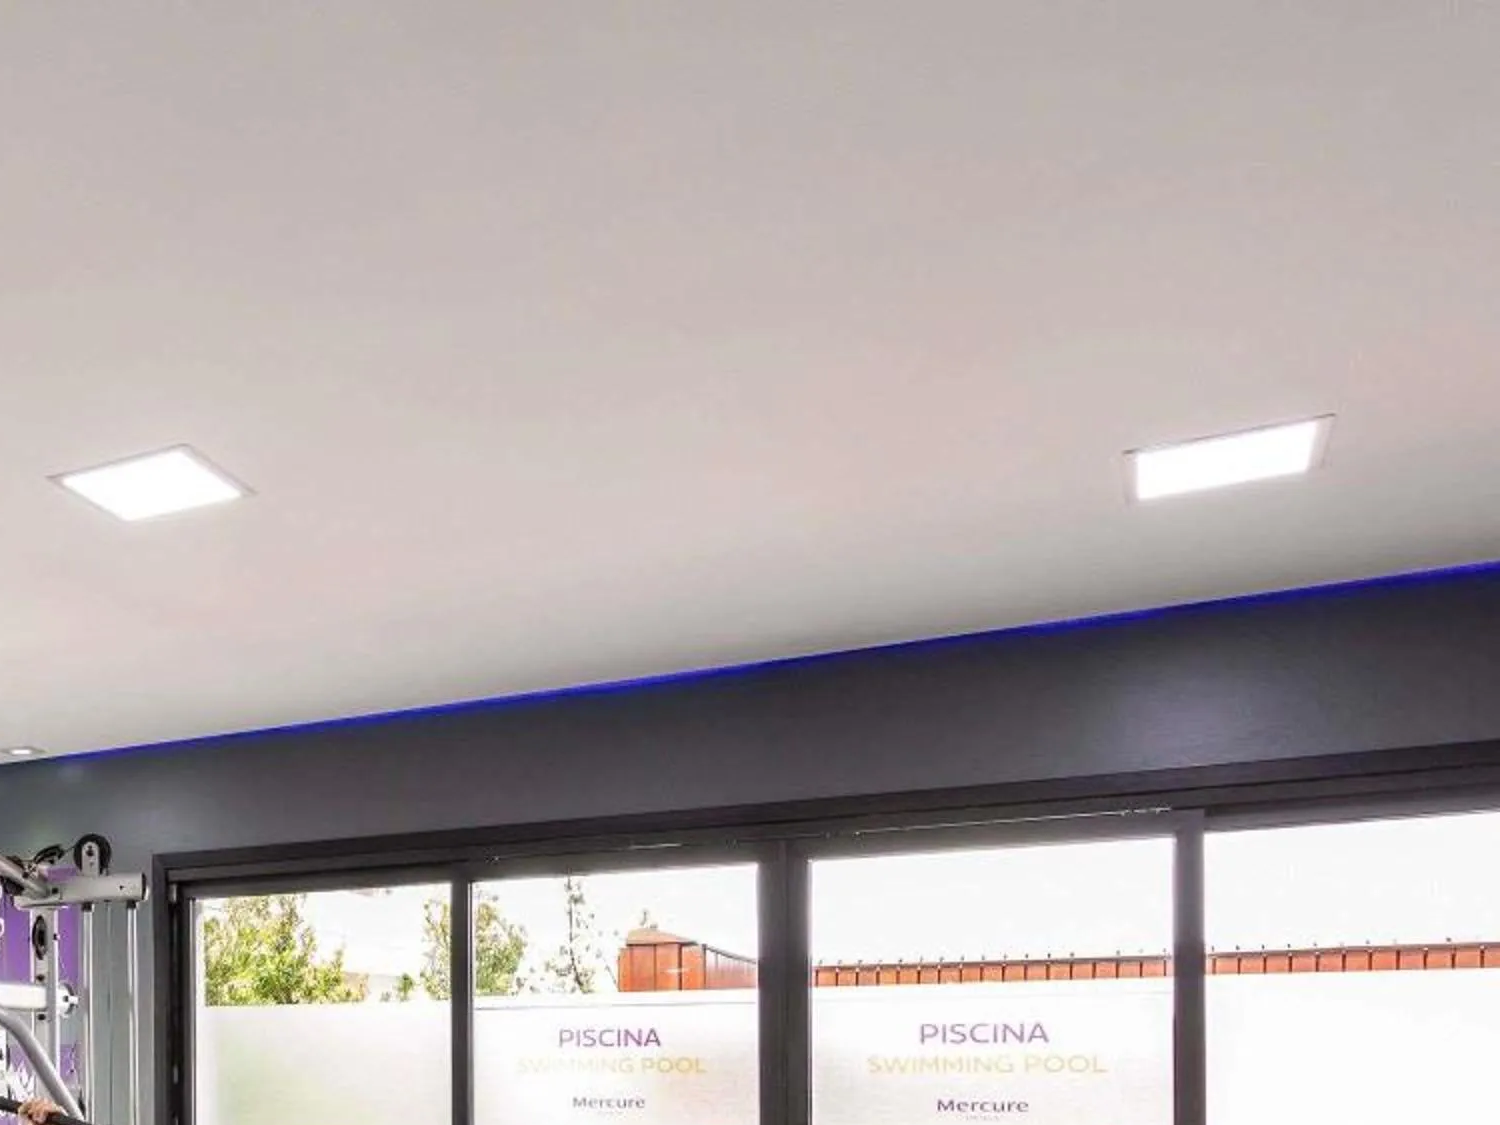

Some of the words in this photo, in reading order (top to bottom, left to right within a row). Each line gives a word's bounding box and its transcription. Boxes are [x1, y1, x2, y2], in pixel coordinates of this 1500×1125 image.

[558, 1027, 662, 1048] PISCINA
[919, 1021, 1050, 1045] PISCINA
[517, 1056, 635, 1074] SWIMMING
[641, 1056, 708, 1074] POOL
[866, 1054, 1015, 1075] SWIMMING
[1025, 1054, 1109, 1074] POOL
[572, 1096, 646, 1109] Mercure
[936, 1099, 1030, 1113] Mercure
